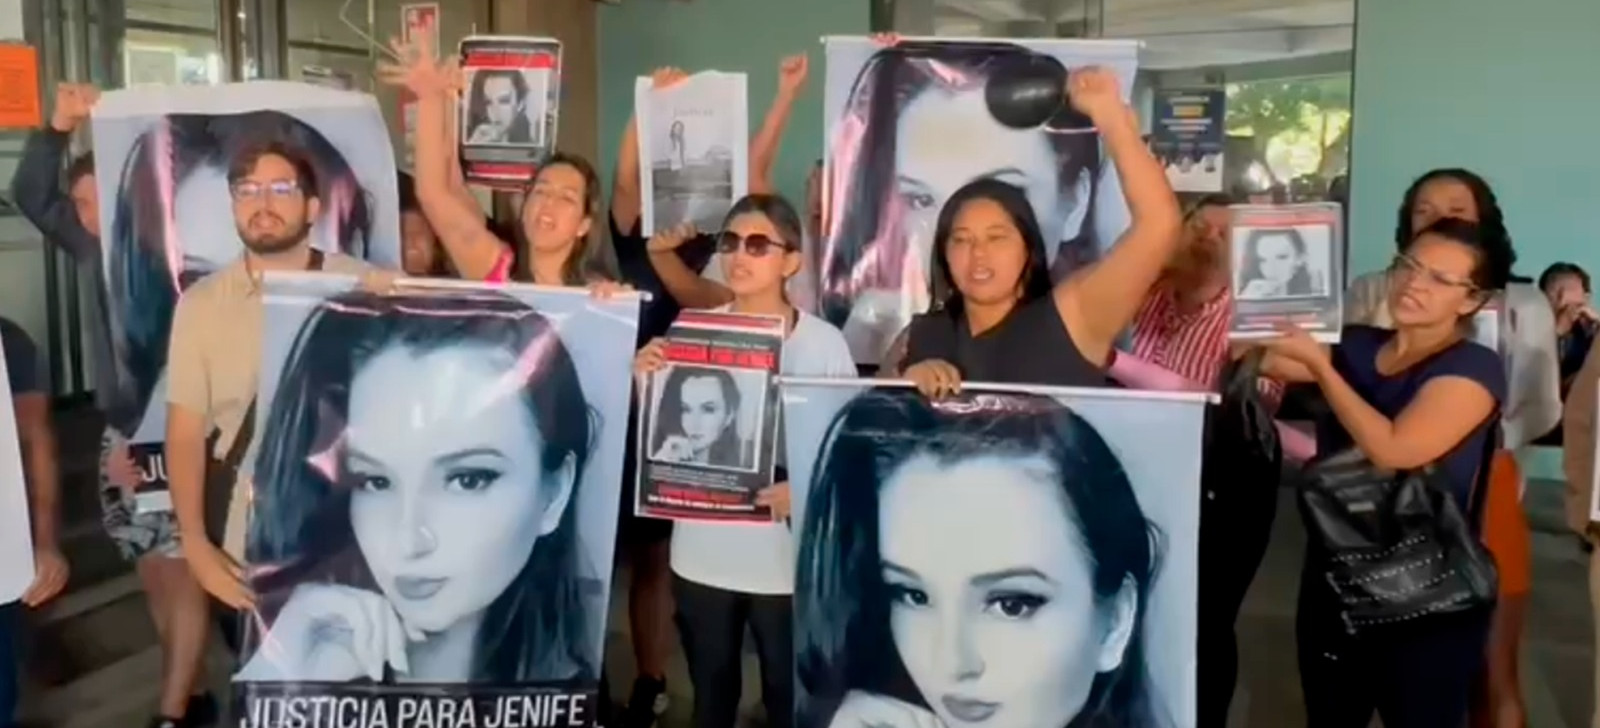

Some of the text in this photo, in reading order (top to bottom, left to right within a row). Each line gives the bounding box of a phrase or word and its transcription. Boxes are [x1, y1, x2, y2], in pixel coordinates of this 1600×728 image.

[239, 694, 604, 728] JUSTICIA PARA JENIFE
